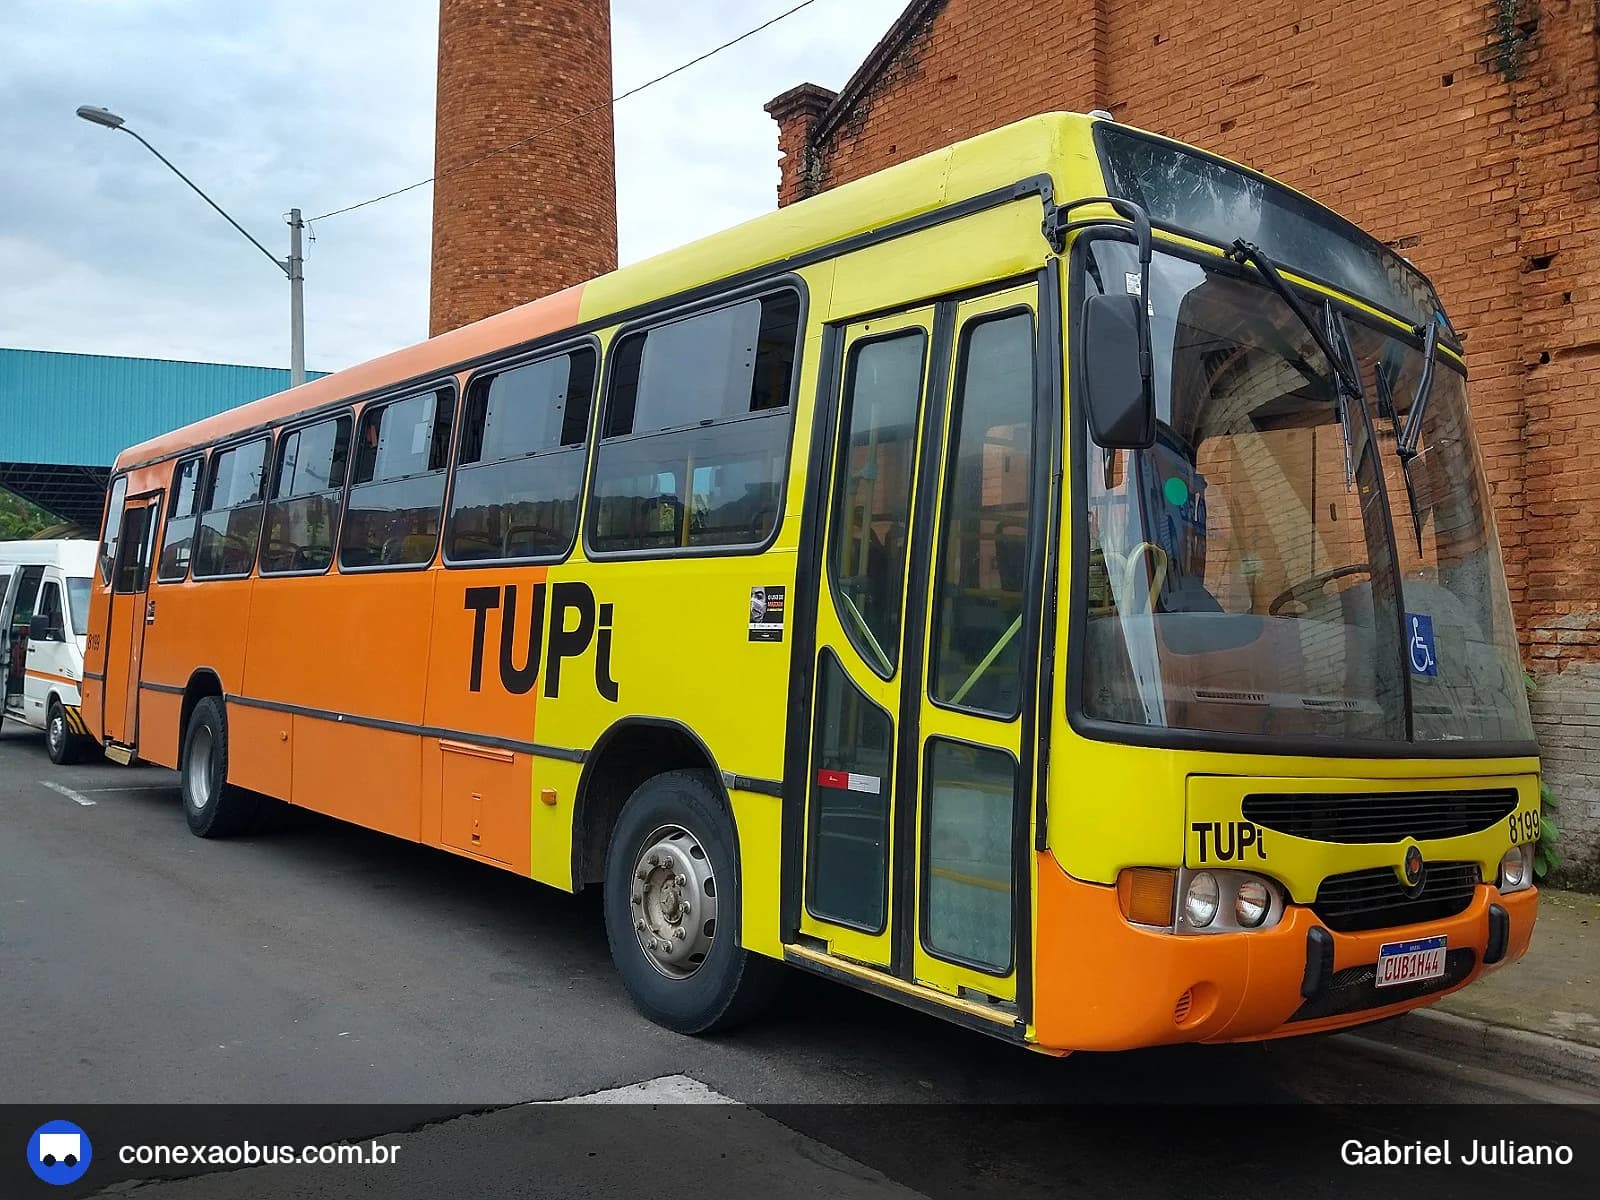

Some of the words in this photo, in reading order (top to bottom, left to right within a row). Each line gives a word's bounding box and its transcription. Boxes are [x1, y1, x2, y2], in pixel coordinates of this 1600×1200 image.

[87, 633, 100, 651] 8199
[464, 582, 619, 703] TUPi
[1191, 822, 1267, 862] TUPi
[1509, 809, 1540, 844] 8199
[1384, 951, 1439, 981] CUB1H44
